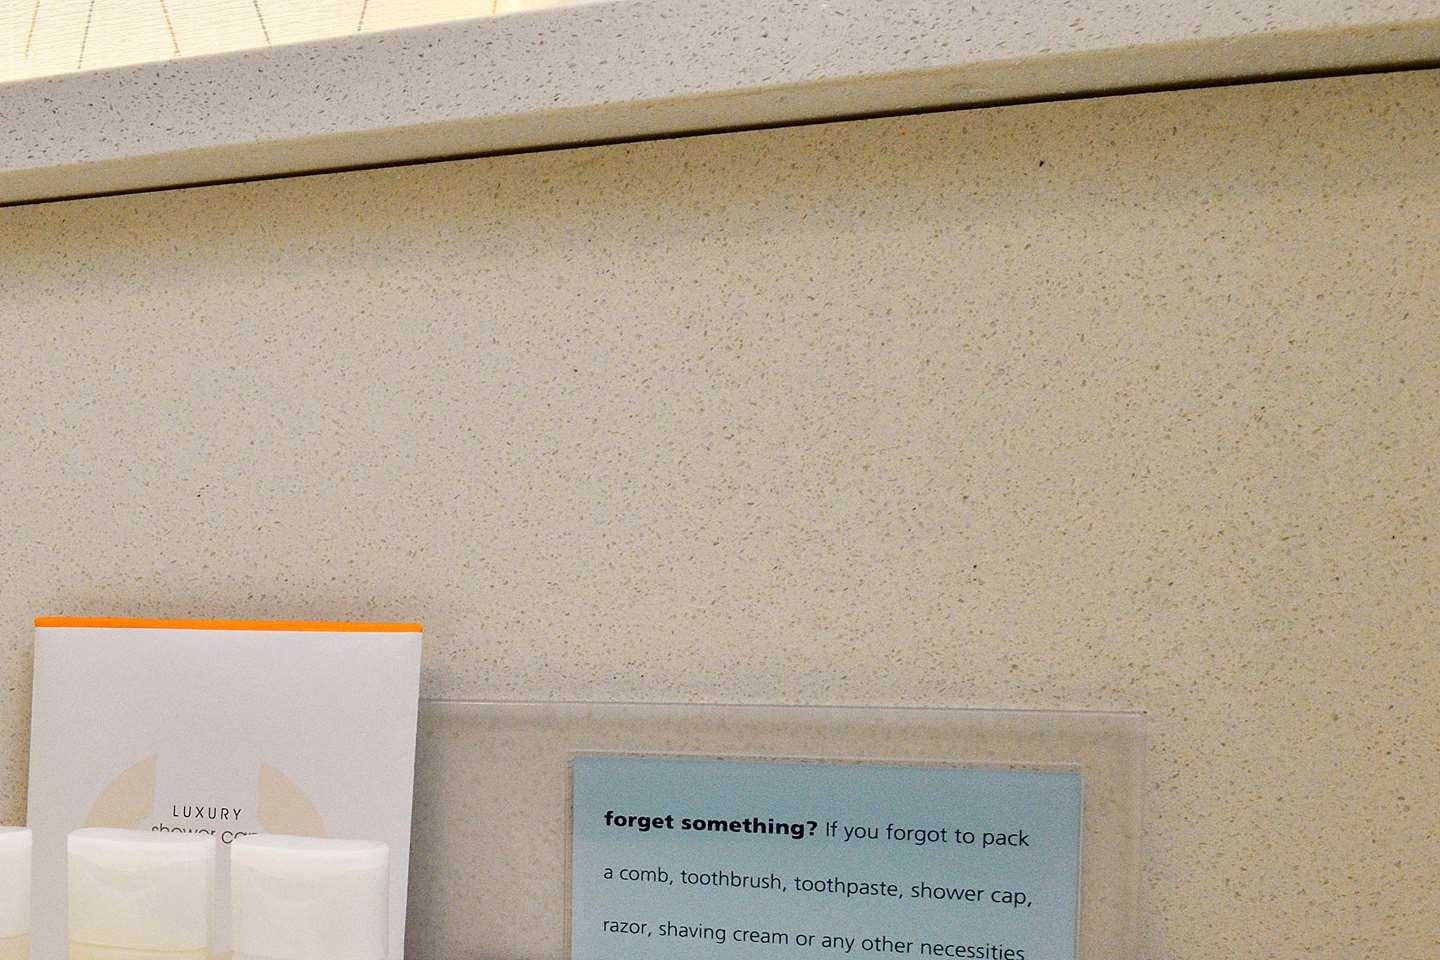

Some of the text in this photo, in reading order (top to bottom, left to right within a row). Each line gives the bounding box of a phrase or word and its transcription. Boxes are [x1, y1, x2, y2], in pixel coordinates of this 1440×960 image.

[172, 804, 242, 821] LUXURY
[603, 810, 1030, 849] forget something? If you forgot to pack
[603, 866, 1032, 909] a comb, toothbrush, toothpaste, shower cap,
[603, 920, 652, 938] razor,
[658, 920, 726, 945] shaving
[732, 929, 789, 945] cream
[795, 934, 816, 947] or
[821, 935, 855, 954] any
[861, 935, 914, 954] other
